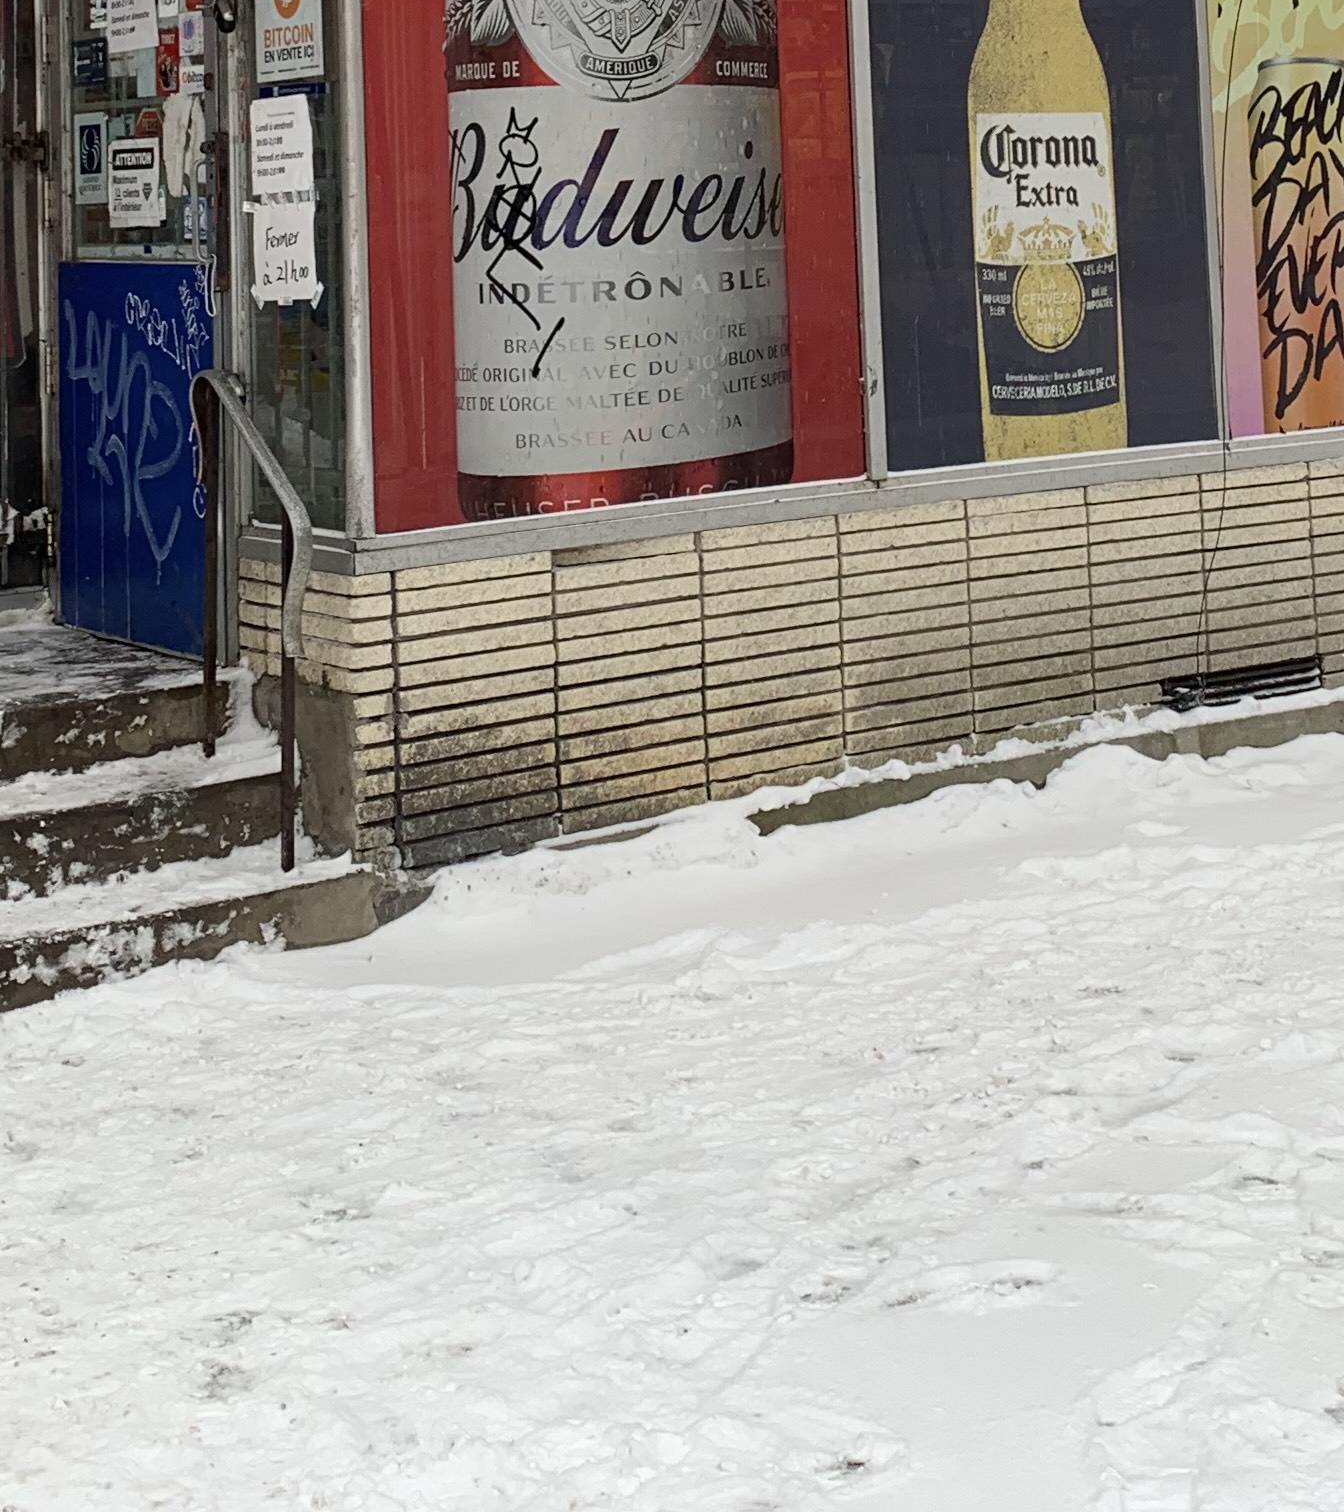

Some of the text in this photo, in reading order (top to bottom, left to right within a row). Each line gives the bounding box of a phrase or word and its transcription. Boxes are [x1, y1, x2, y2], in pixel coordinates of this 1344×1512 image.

[264, 23, 314, 49] BITCOIN
[264, 51, 275, 63] EN
[276, 46, 303, 62] VENTE
[455, 60, 769, 81] MARQUE DE COMMERCE
[585, 56, 653, 75] AMERIQUE
[114, 152, 152, 166] ATTENTION
[980, 124, 1099, 184] Corona
[1014, 173, 1079, 208] Extra
[981, 269, 996, 281] 330
[1021, 291, 1078, 306] CERVEZA
[604, 331, 678, 351] SELON
[579, 362, 637, 380] AVEC
[648, 360, 678, 376] DU
[478, 396, 496, 412] DE
[500, 394, 557, 412] L'ORGE
[658, 387, 685, 404] DE
[621, 427, 653, 444] AU
